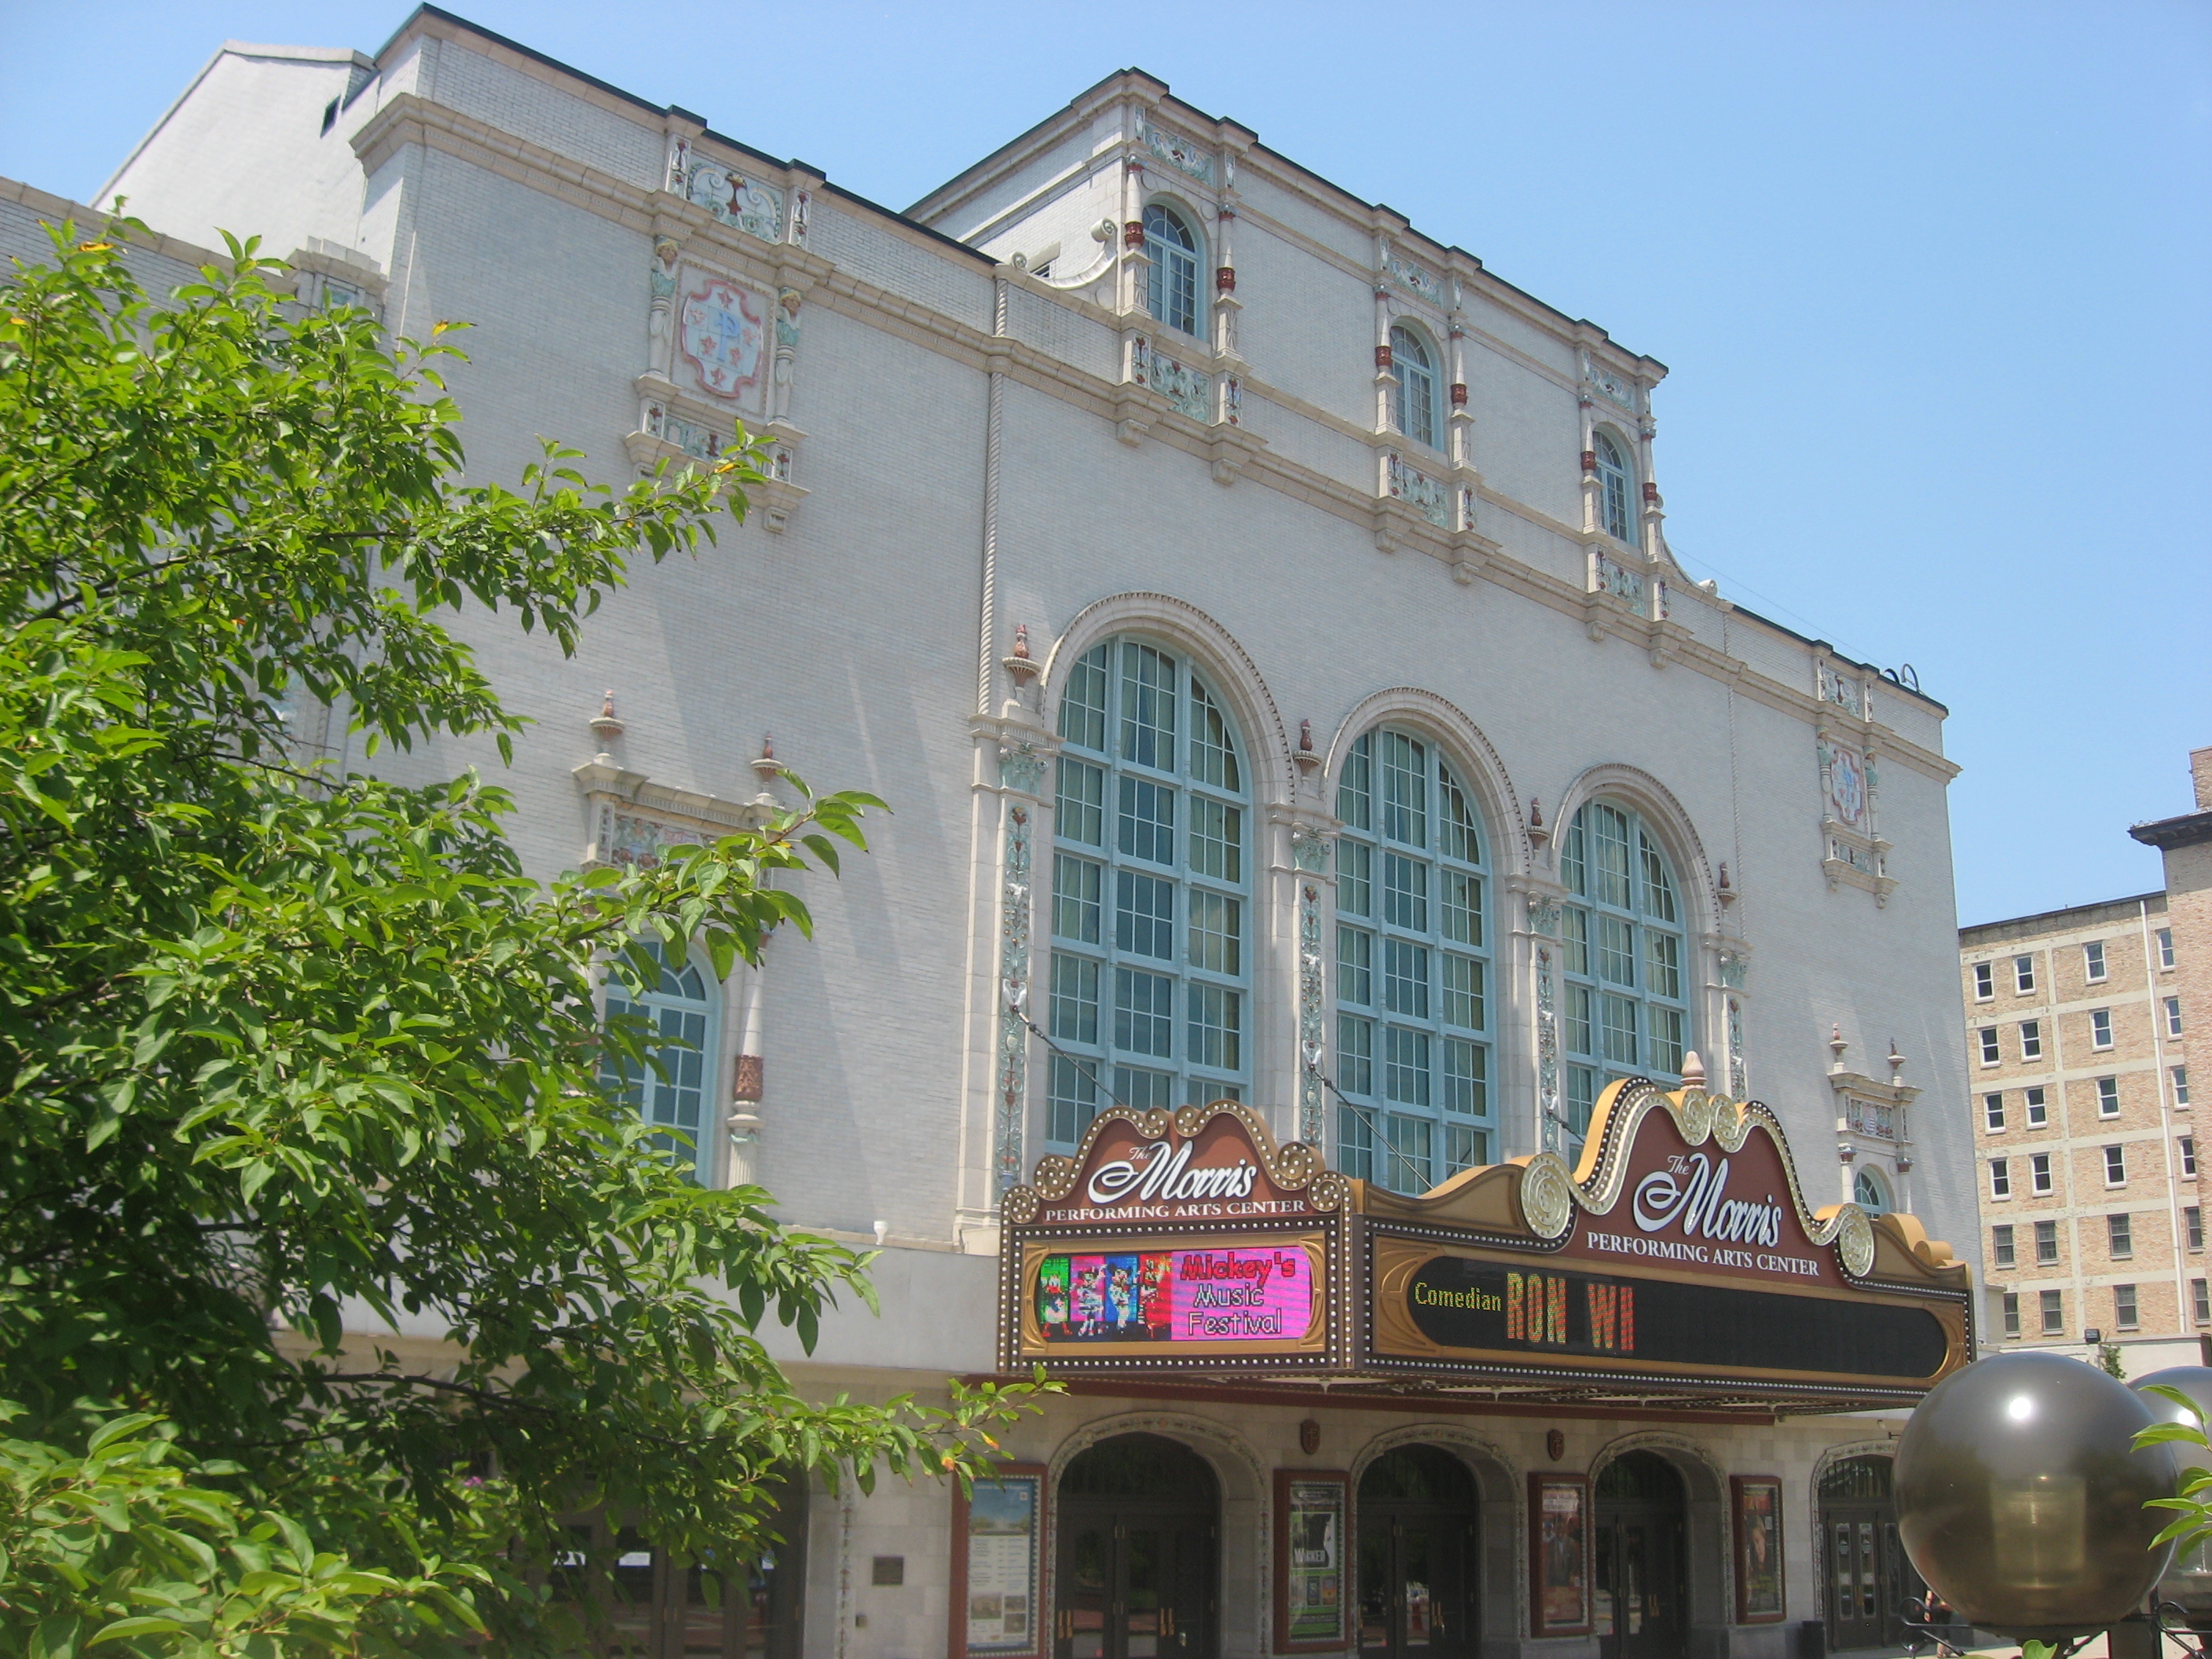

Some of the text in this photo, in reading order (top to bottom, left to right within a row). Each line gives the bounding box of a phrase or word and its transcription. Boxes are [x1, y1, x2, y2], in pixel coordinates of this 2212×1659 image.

[1128, 1145, 1152, 1161] The
[1667, 1155, 1689, 1175] The
[1087, 1139, 1257, 1203] Morris
[1046, 1199, 1306, 1221] PERFORMING ARTS CENTER
[1632, 1152, 1782, 1248] Morris
[1180, 1251, 1296, 1287] Mickey's
[1587, 1231, 1819, 1276] PERFORMING ARTS CENTER
[1193, 1282, 1265, 1307] Music
[1414, 1281, 1502, 1312] Comedian
[1507, 1272, 1566, 1344] RON
[1188, 1307, 1282, 1335] Festival
